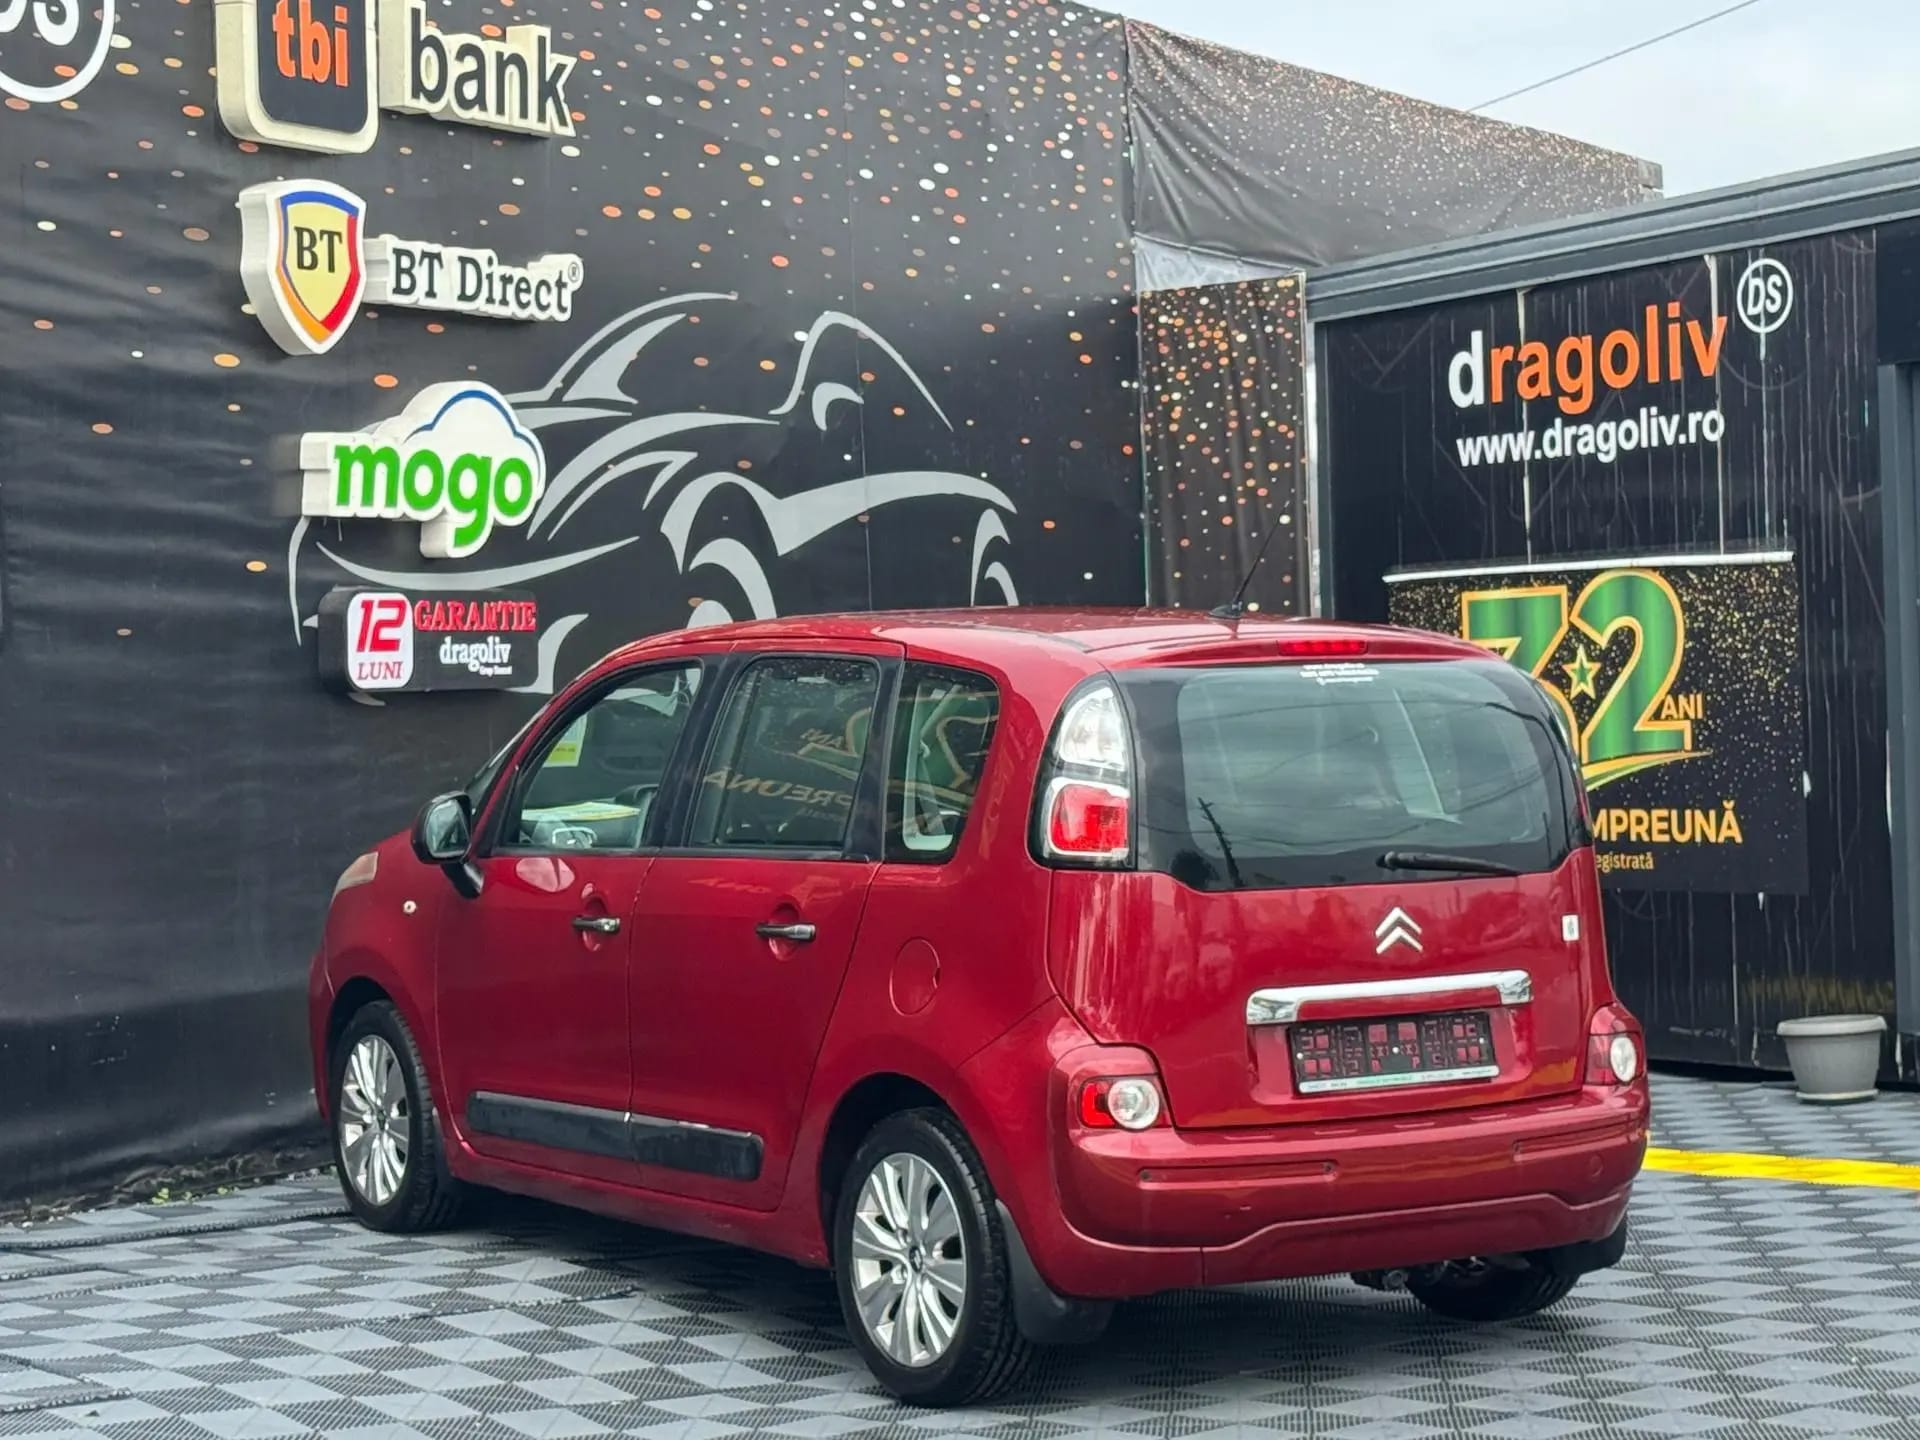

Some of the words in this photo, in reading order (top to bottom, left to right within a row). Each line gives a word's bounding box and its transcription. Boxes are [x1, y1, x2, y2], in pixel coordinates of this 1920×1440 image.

[272, 0, 348, 87] tbi
[411, 7, 569, 127] bank
[294, 226, 342, 273] BT
[392, 248, 444, 299] BT
[1747, 274, 1783, 316] DS
[1448, 302, 1728, 415] dragoliv
[1456, 406, 1726, 467] www.dragoliv.ro
[334, 444, 534, 548] mogo
[356, 599, 408, 652] 12
[413, 599, 538, 632] GARANTIE
[357, 660, 404, 681] LUNI
[439, 635, 512, 672] dragoliv
[1660, 693, 1705, 720] ANI
[1592, 800, 1744, 843] MPREUNĂ
[1596, 852, 1655, 873] egistrată
